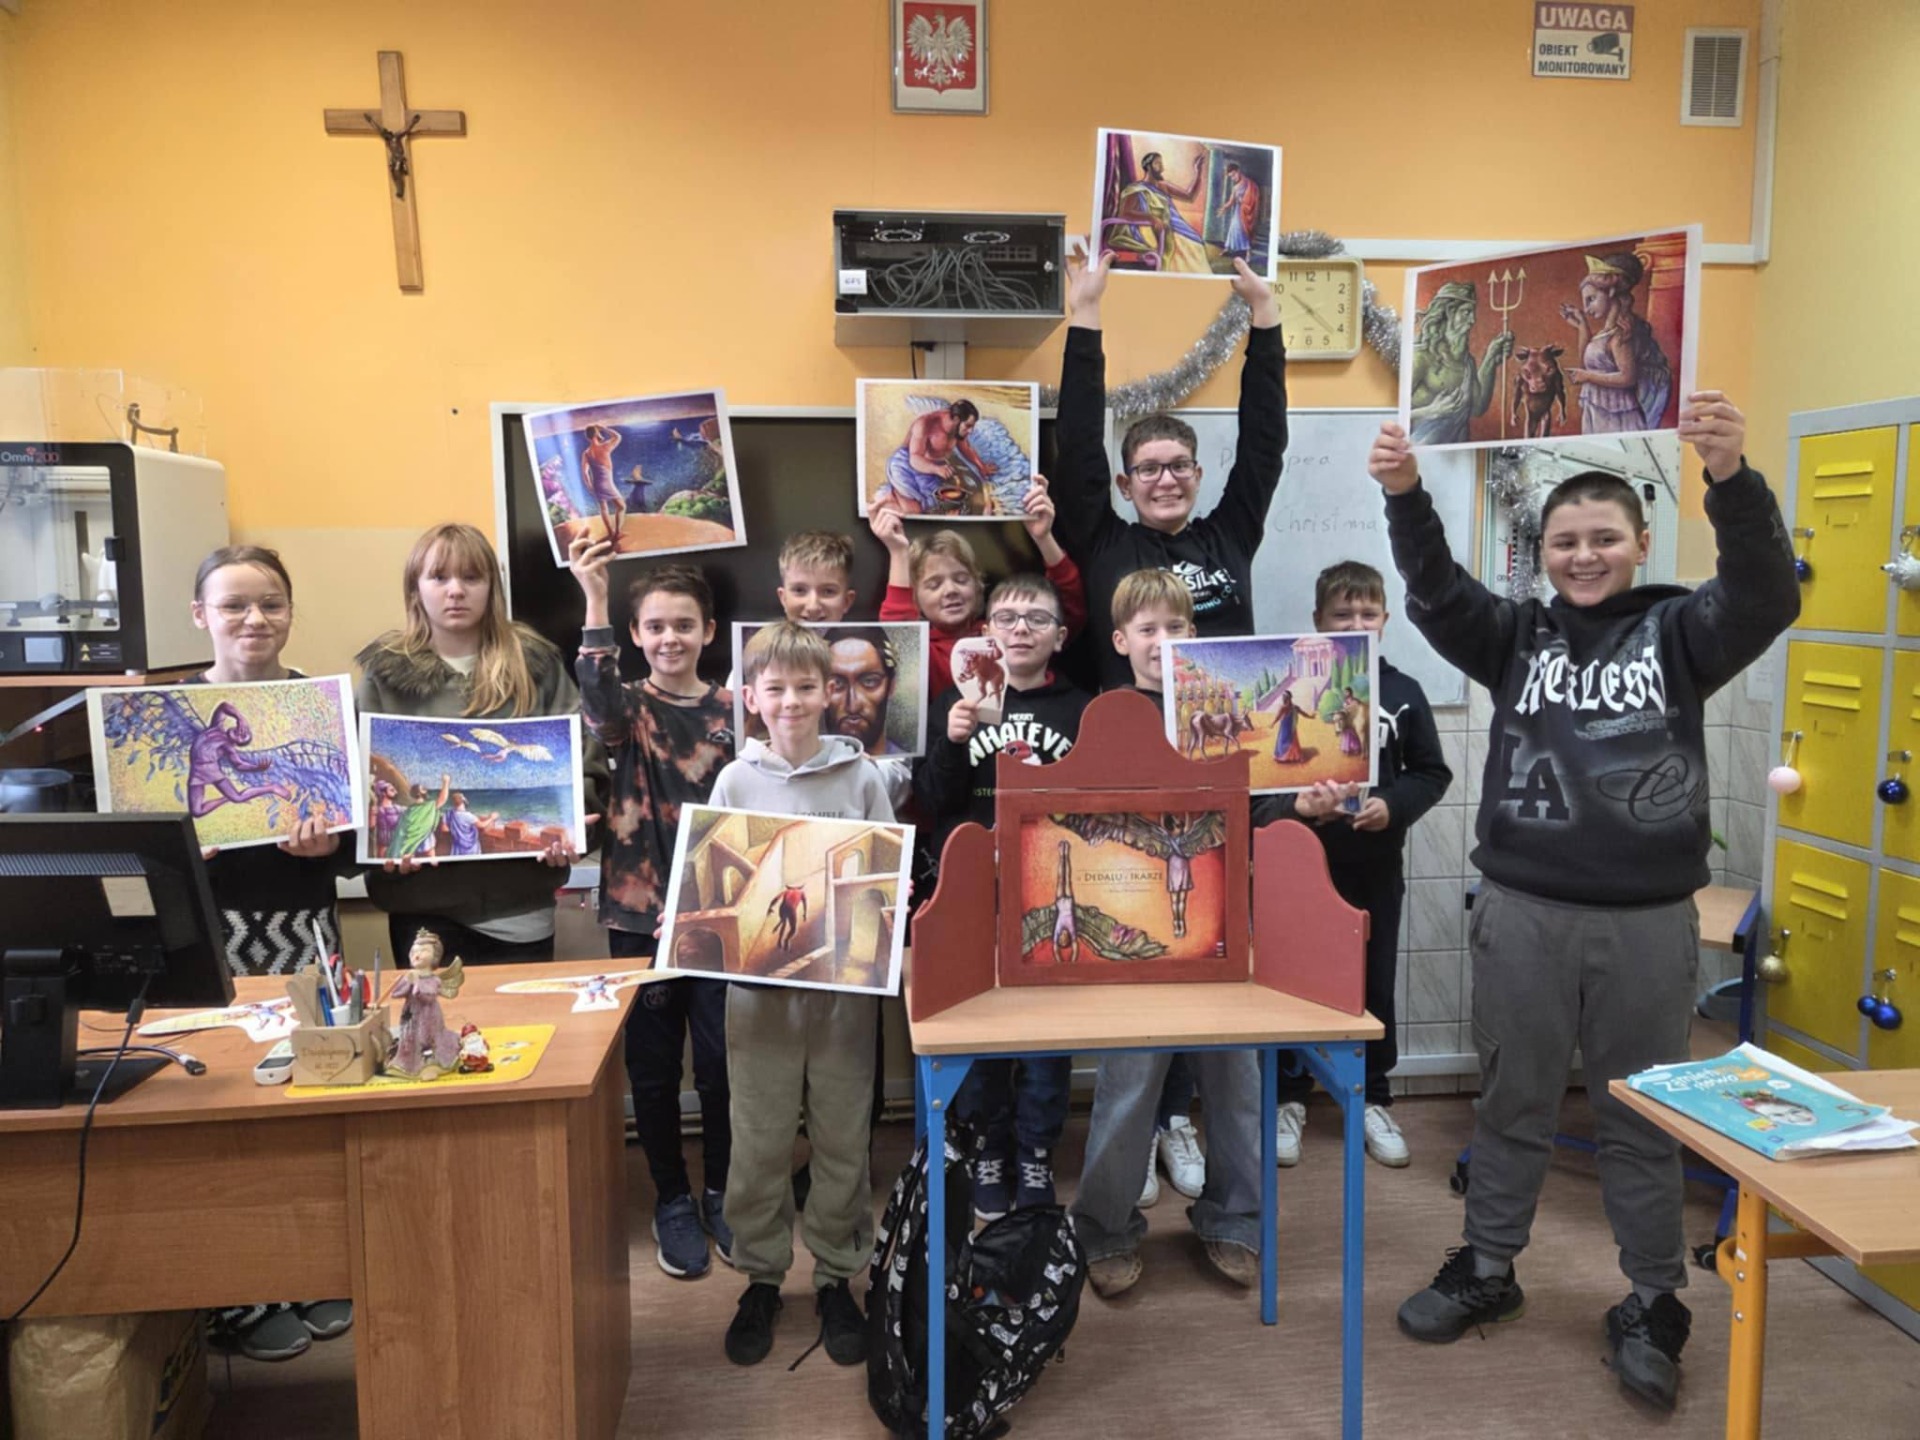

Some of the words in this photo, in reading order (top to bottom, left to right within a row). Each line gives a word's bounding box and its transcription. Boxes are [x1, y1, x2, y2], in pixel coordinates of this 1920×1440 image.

[1540, 6, 1628, 30] UWAGA
[1539, 43, 1578, 56] OBIEKT
[1538, 60, 1626, 75] MONITOROWANY
[1289, 271, 1298, 282] 11
[1305, 270, 1316, 282] 12
[1326, 271, 1331, 282] 1
[1274, 283, 1285, 295] 10
[1338, 283, 1346, 294] 2
[1337, 303, 1345, 314] 3
[1337, 323, 1344, 333] 4
[1305, 335, 1312, 346] 6
[1323, 335, 1330, 346] 5
[1008, 713, 1034, 721] MERRY
